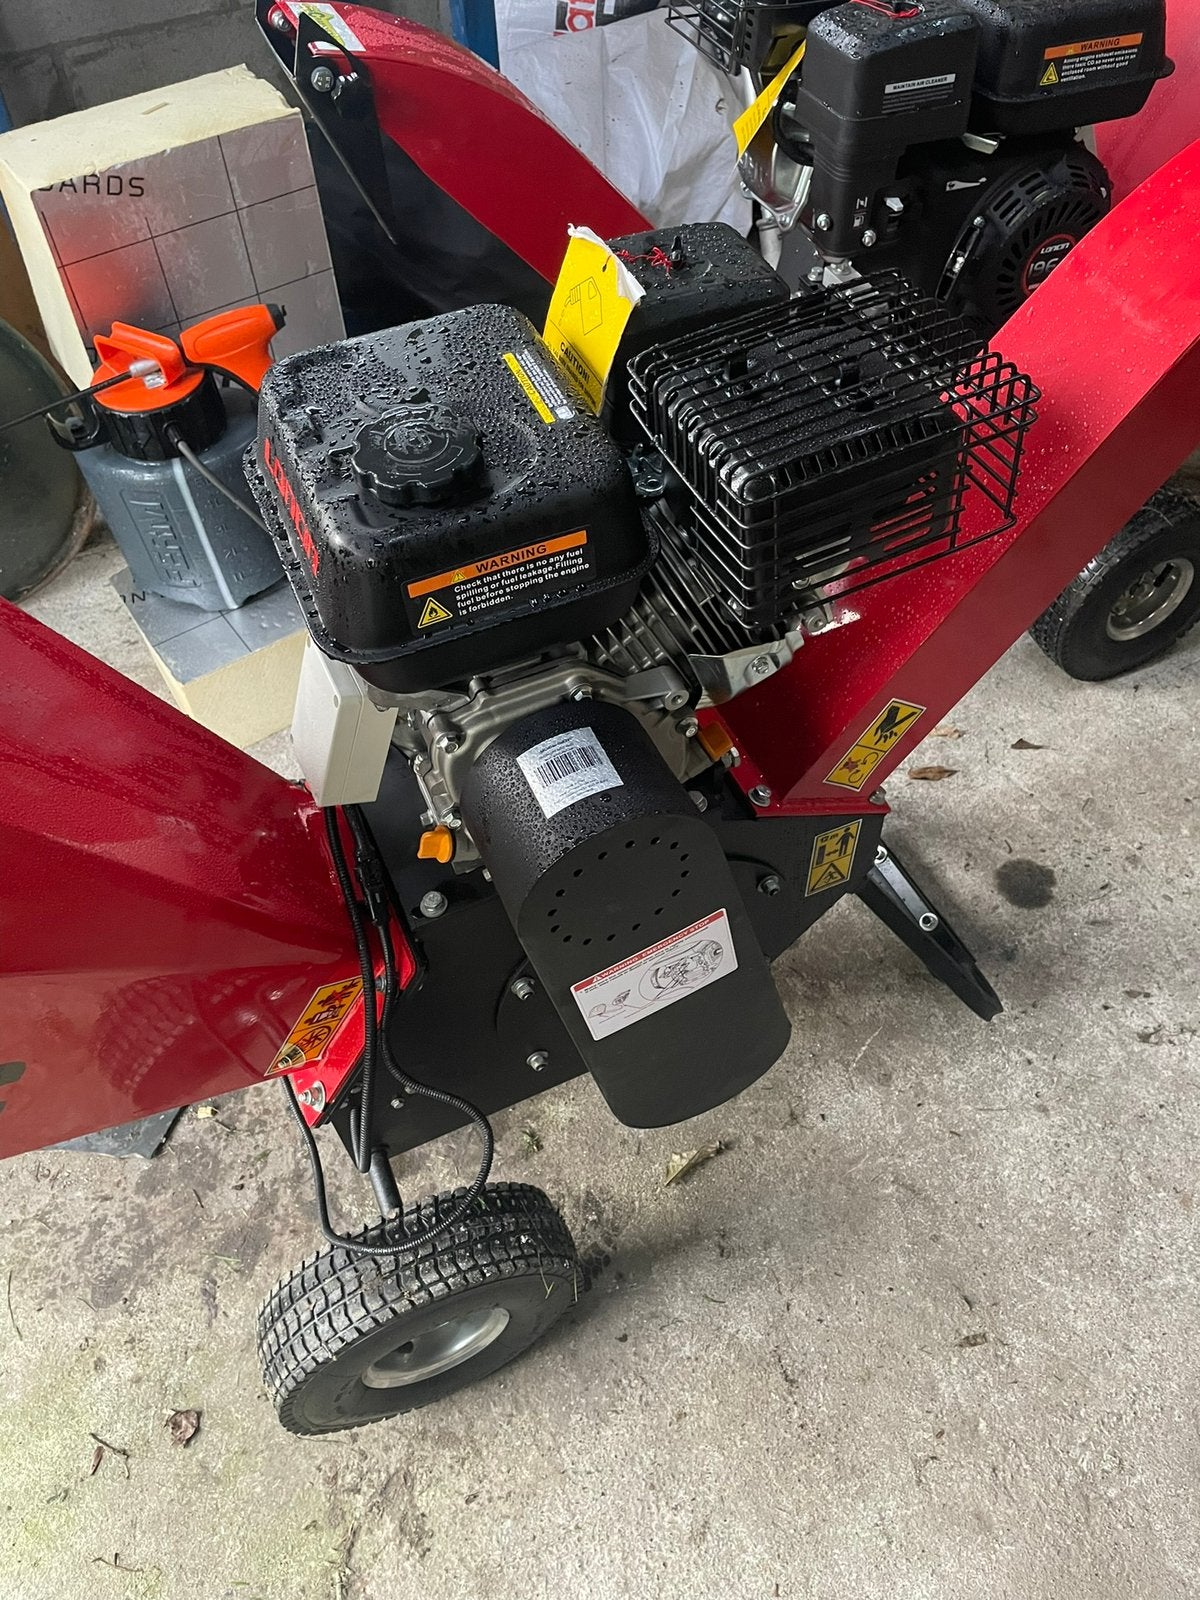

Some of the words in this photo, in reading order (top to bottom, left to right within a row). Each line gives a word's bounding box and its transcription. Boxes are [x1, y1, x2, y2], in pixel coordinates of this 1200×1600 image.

[1080, 38, 1120, 52] WARNING
[1080, 54, 1095, 62] engine
[1115, 48, 1137, 56] emissions
[1097, 62, 1115, 70] without
[892, 82, 916, 90] MAINTAIN
[925, 76, 948, 85] CLEANER
[38, 174, 145, 197] ARDS
[560, 342, 590, 384] CAUTION!
[454, 580, 482, 593] Check
[483, 573, 501, 584] that
[502, 566, 525, 578] there
[536, 559, 548, 567] no
[549, 554, 565, 563] any
[566, 548, 583, 558] fuel
[475, 544, 547, 574] WARNING
[456, 586, 489, 601] spilling
[490, 582, 500, 590] or
[501, 575, 518, 586] fuel
[457, 598, 475, 609] fuel
[476, 589, 504, 602] before
[505, 576, 544, 593] stopping
[545, 572, 559, 580] the
[560, 563, 590, 576] engine
[468, 594, 514, 612] forbidden.
[642, 931, 689, 958] EMERGENCY
[689, 919, 710, 933] STOP
